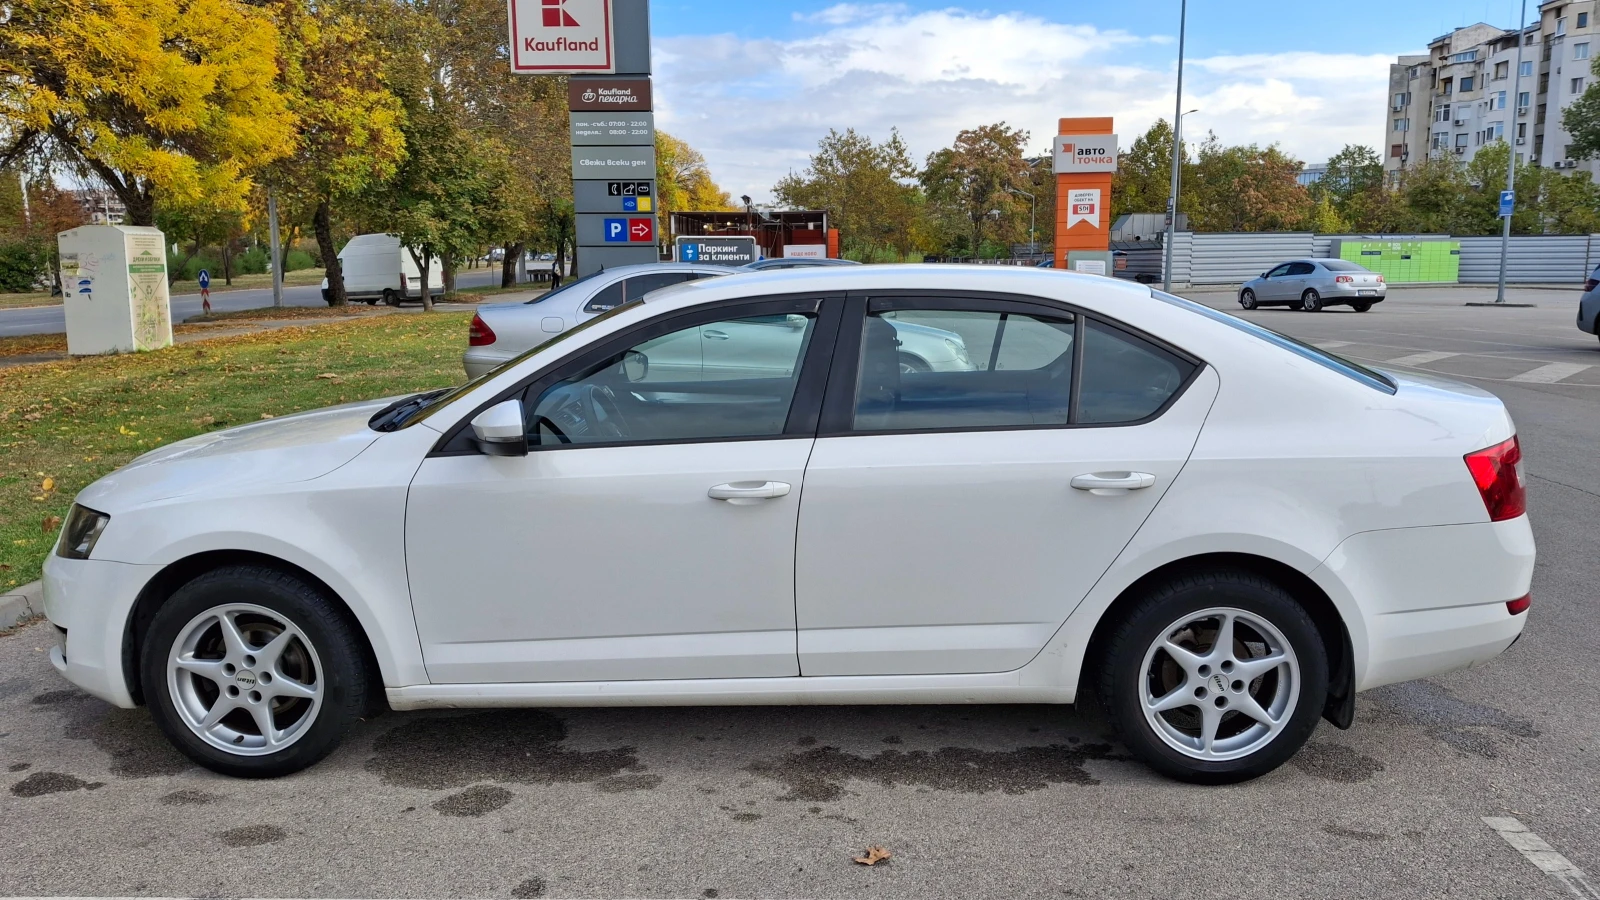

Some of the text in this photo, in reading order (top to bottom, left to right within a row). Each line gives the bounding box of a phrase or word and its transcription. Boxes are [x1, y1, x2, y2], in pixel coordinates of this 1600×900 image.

[524, 37, 599, 52] Kaufland
[598, 95, 638, 105] пекарна
[1077, 147, 1105, 156] авто
[1077, 156, 1113, 165] точка
[610, 222, 622, 238] P
[698, 243, 738, 254] Паркинг
[1213, 676, 1225, 692] titan
